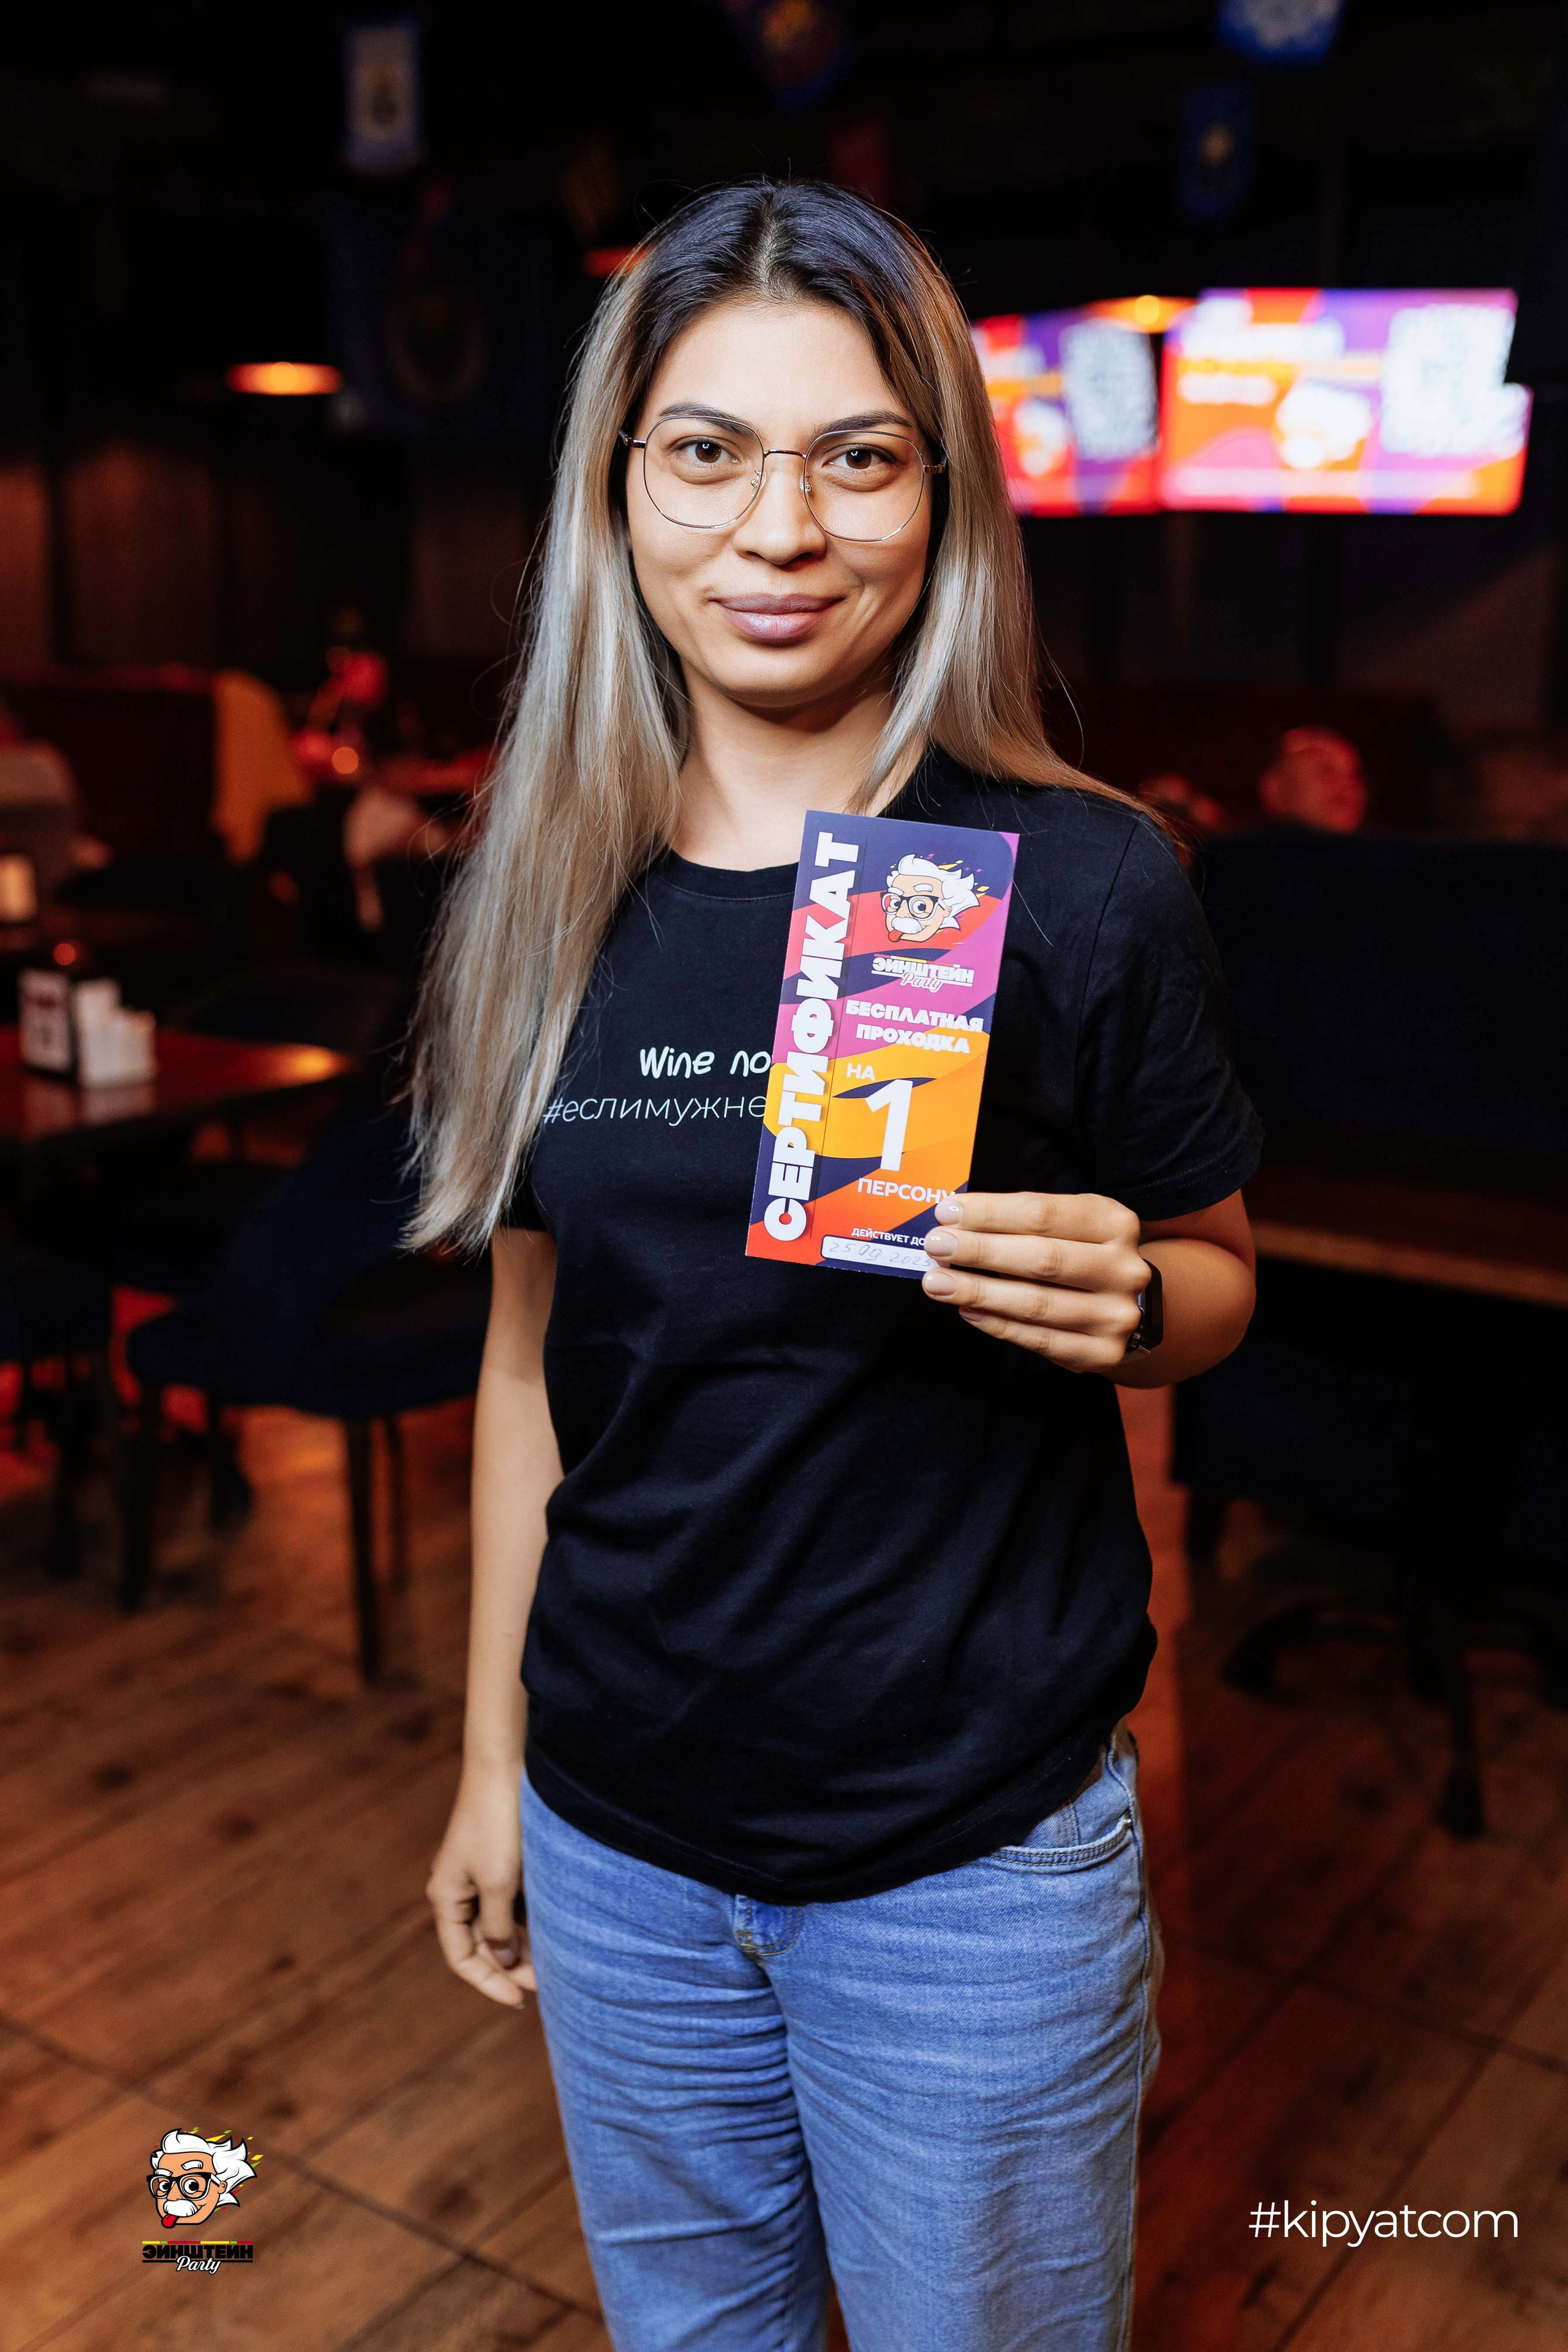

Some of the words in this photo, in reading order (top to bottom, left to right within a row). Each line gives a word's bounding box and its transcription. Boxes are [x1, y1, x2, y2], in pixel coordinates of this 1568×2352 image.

[900, 971, 944, 993] Party
[845, 999, 984, 1033] БЕСПЛАТНАЯ
[763, 832, 859, 1242] СЕРТИФИКАТ
[856, 1023, 970, 1054] ПРОХОДКА
[639, 1046, 715, 1079] Wine
[729, 1050, 771, 1077] no
[846, 1063, 875, 1081] НА
[865, 1079, 913, 1172] 1
[851, 1227, 910, 1243] ДЕЙСТВУЕТ
[910, 1236, 925, 1246] ДО
